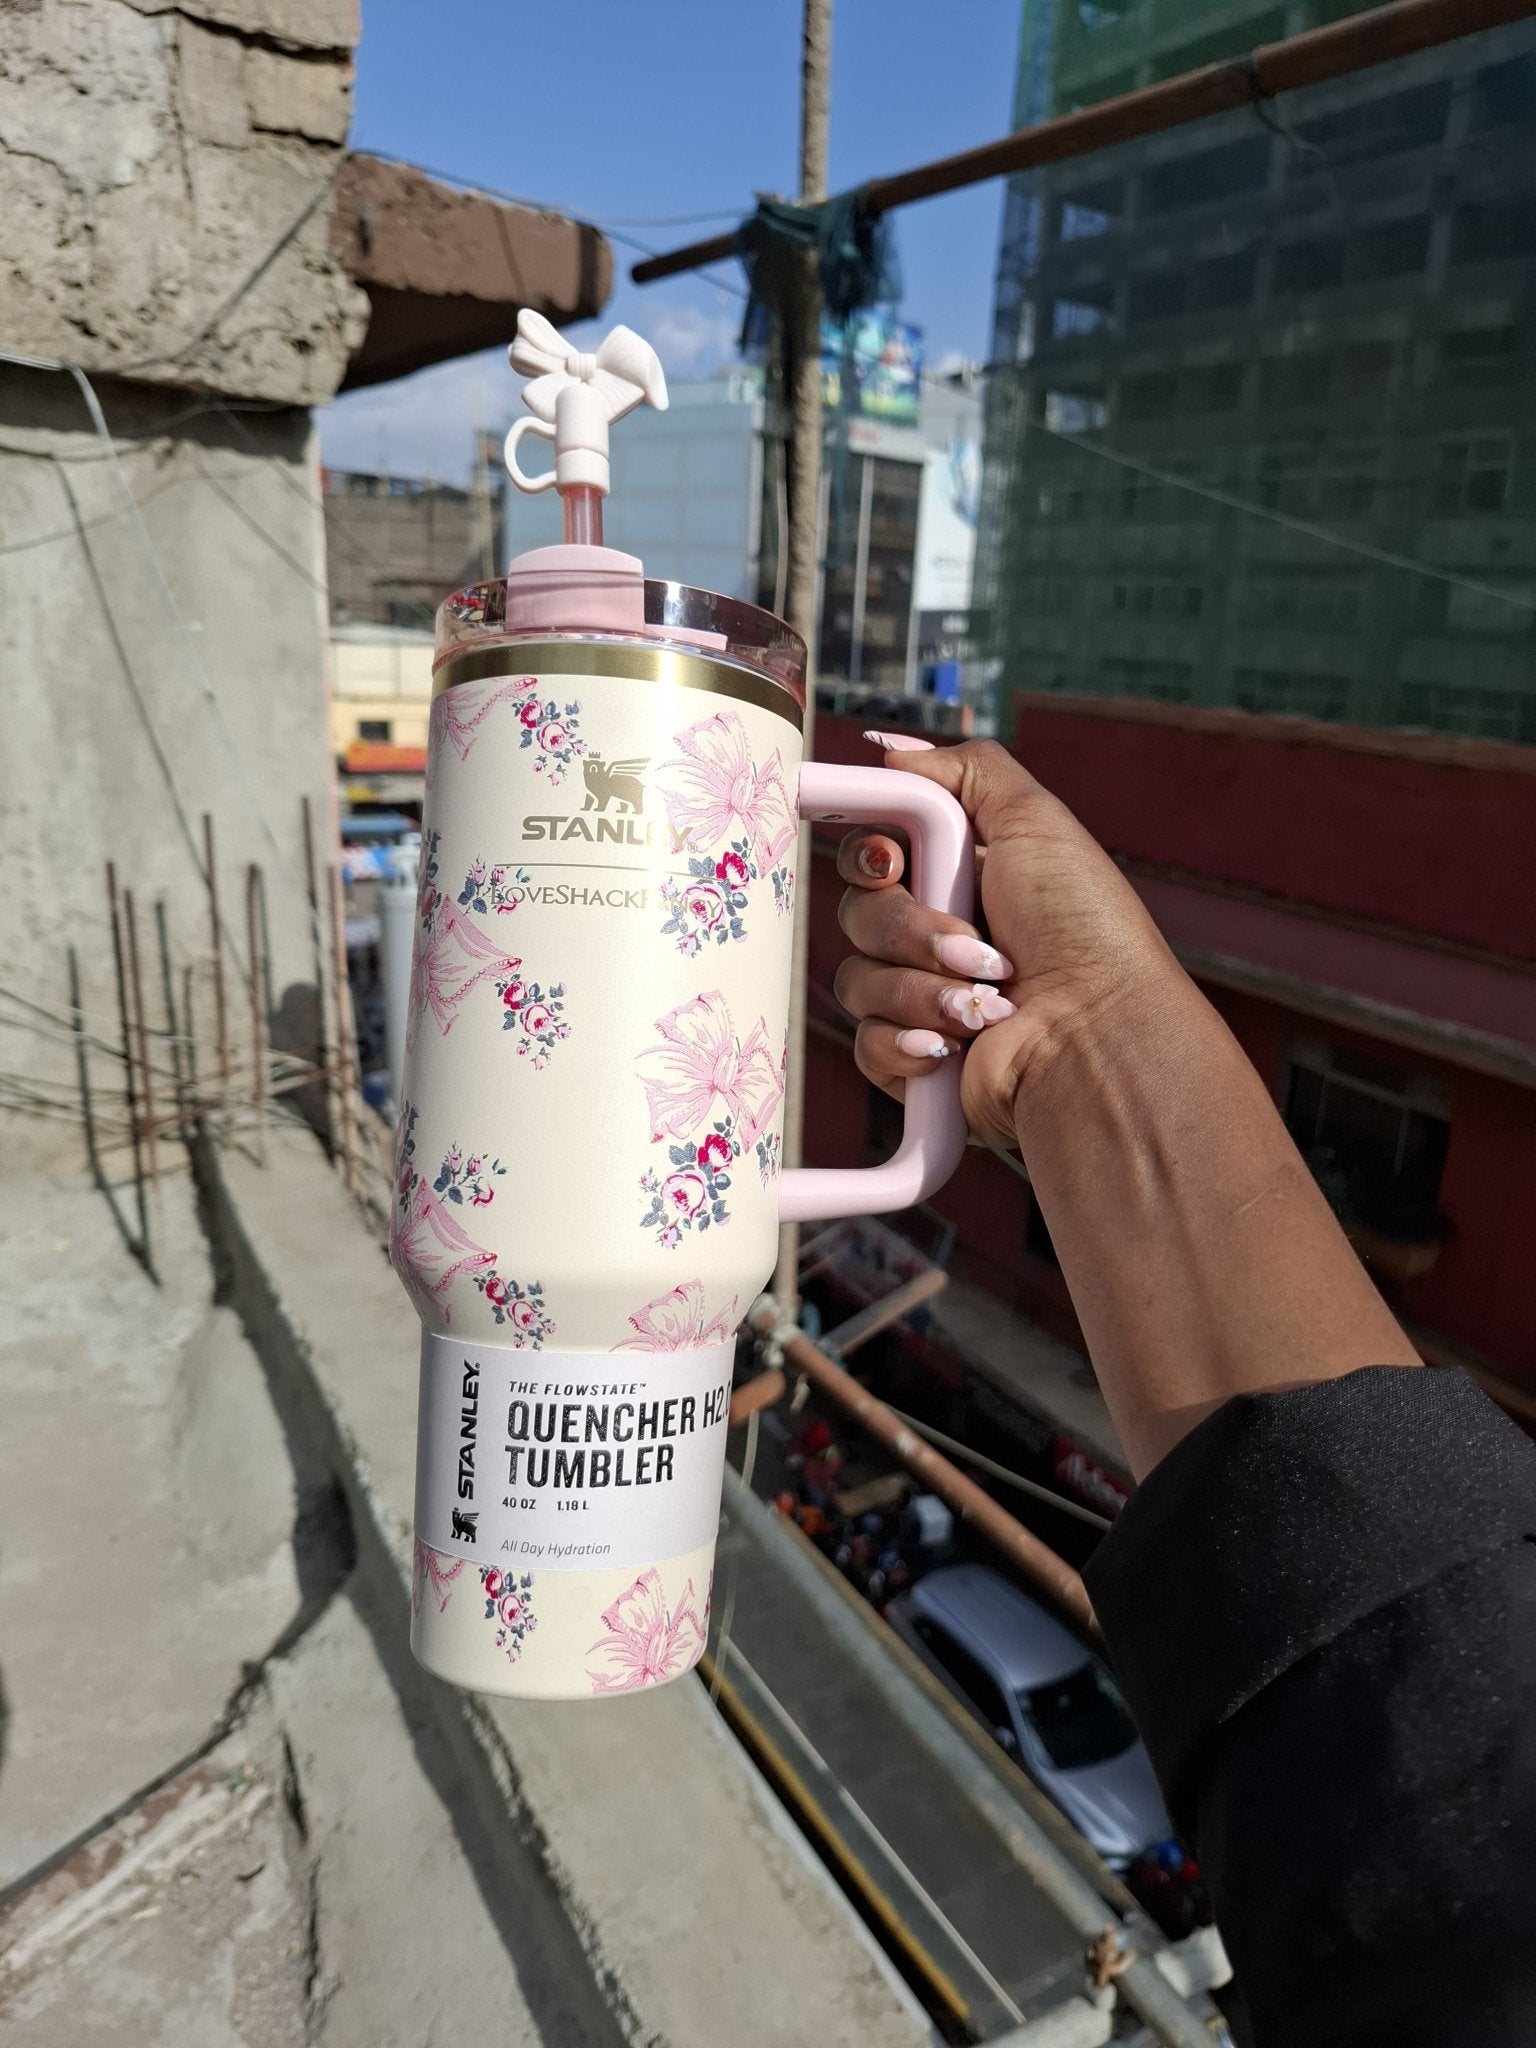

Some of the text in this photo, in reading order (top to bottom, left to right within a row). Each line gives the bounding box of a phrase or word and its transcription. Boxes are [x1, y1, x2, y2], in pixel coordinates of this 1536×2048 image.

[509, 1380, 539, 1395] THE
[507, 1395, 696, 1443] QUENCHER
[504, 1443, 675, 1489] TUMBLER
[502, 1496, 590, 1511] 40 OZ 1.18 L
[500, 1539, 612, 1558] All Day Hydration
